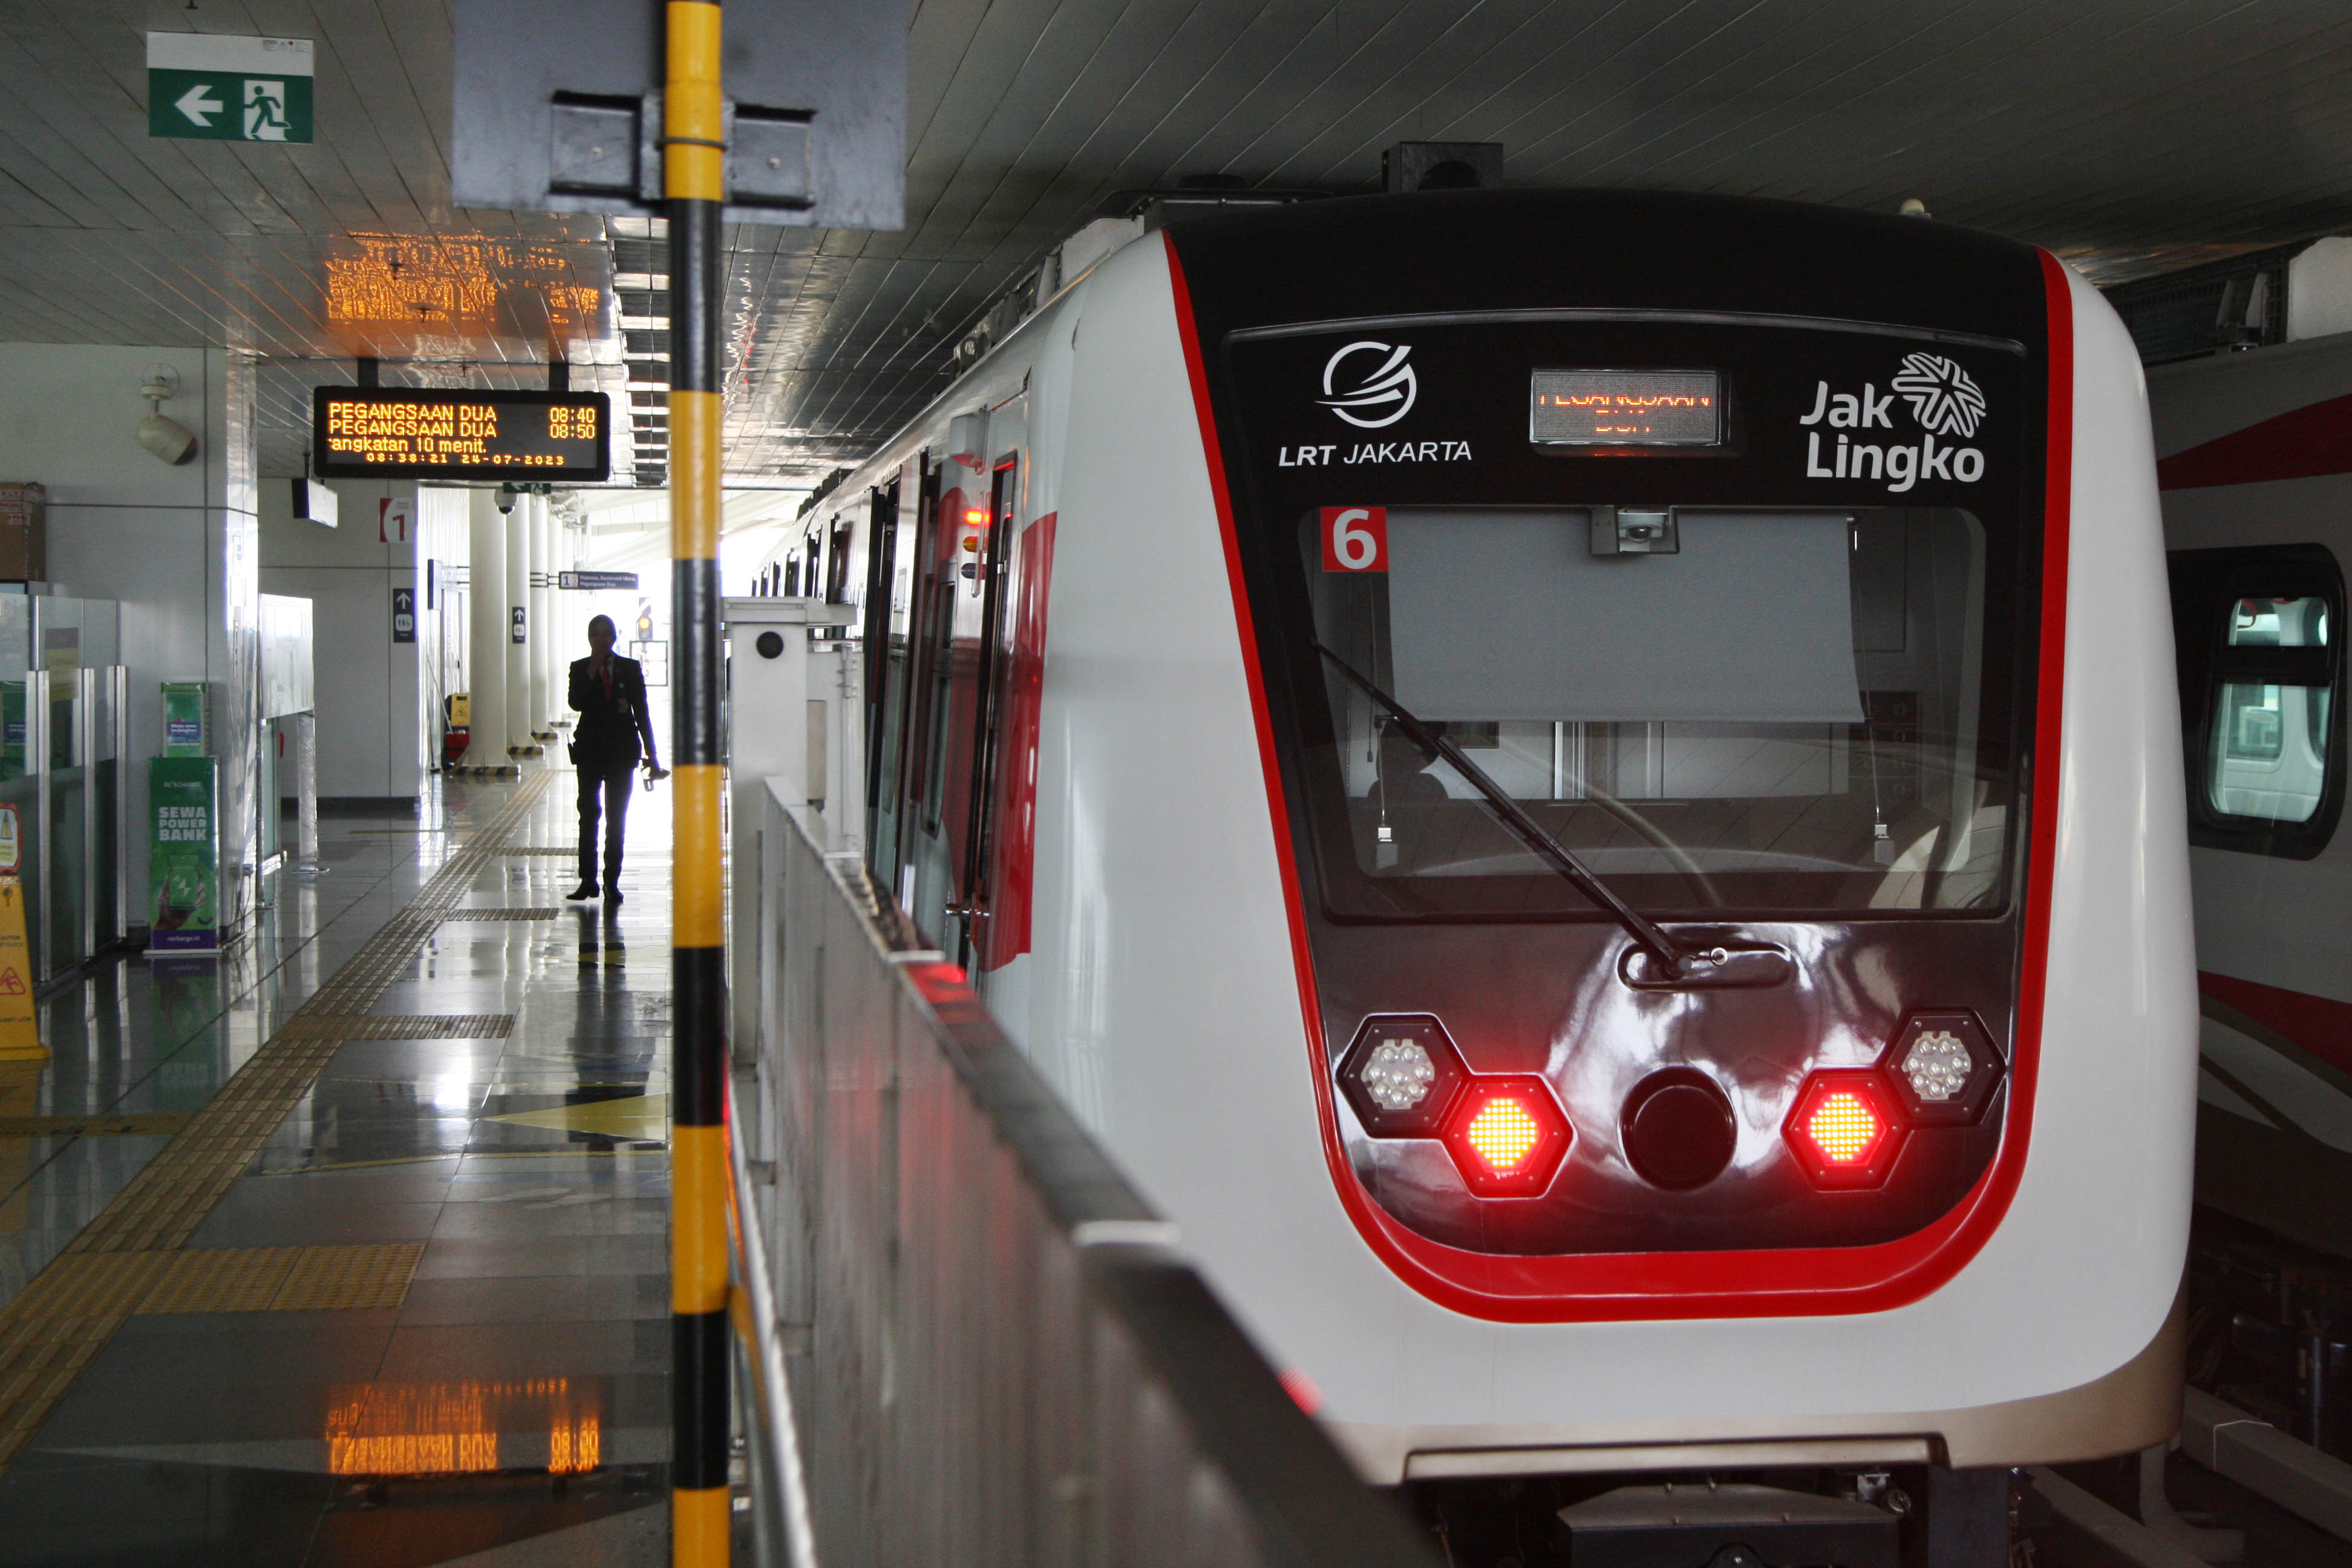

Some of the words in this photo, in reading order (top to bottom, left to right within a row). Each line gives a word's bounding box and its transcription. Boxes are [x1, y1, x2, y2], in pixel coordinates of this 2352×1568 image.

[328, 402, 454, 422] PEGANGSAAN
[459, 405, 497, 422] DUA
[549, 407, 595, 423] 08:40
[1800, 381, 1893, 428] Jak
[328, 419, 454, 437] PEGANGSAAN
[459, 422, 497, 438] DUA
[549, 423, 595, 439] 08:50
[415, 436, 434, 453] 10
[438, 437, 487, 454] menit.
[1278, 445, 1336, 466] LRT
[1343, 441, 1472, 464] JAKARTA
[366, 452, 448, 465] 08:38:21
[462, 454, 564, 466] 24-07-2023
[1807, 433, 1985, 492] Lingko
[392, 514, 405, 541] 1
[1333, 509, 1377, 569] 6
[158, 806, 206, 818] SEWA
[159, 818, 207, 829] POWER
[159, 828, 207, 841] BANK
